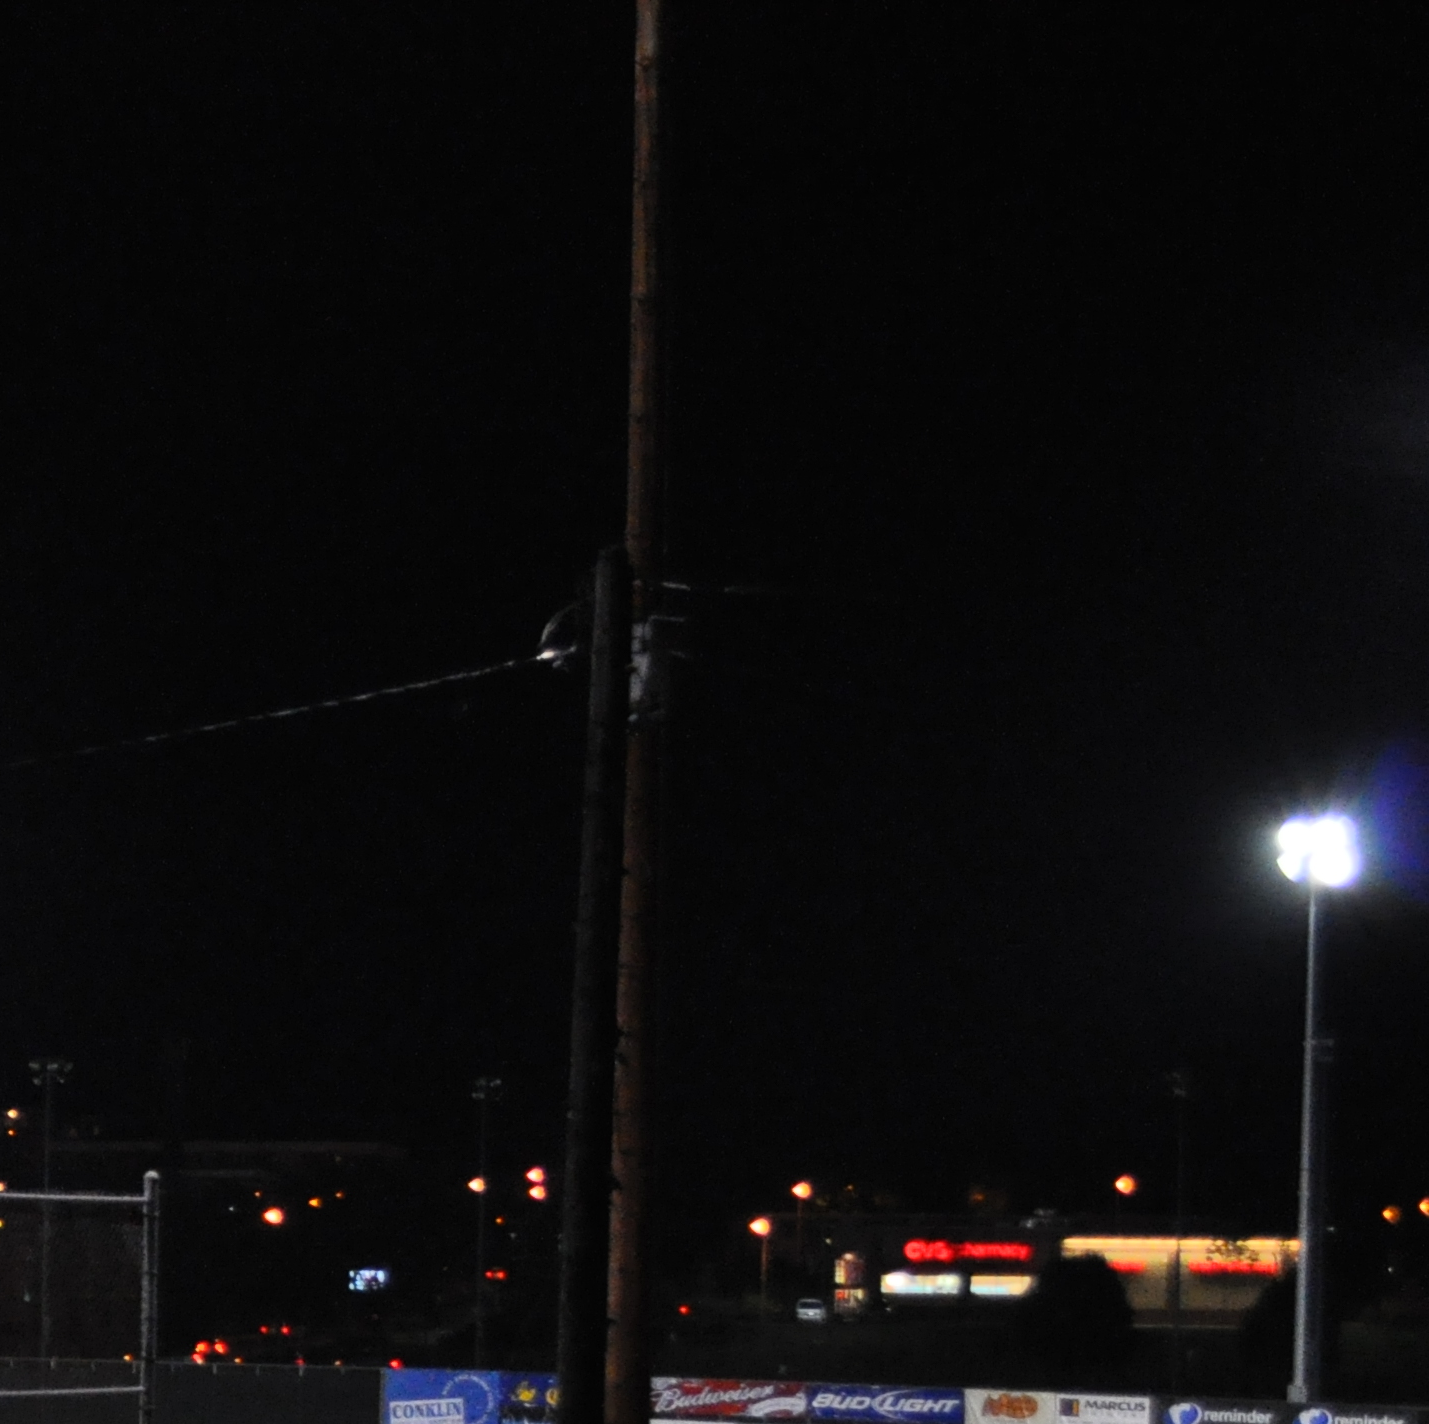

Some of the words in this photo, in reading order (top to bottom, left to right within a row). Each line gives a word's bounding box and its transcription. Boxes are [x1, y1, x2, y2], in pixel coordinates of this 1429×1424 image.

[650, 1385, 774, 1413] Budweiser
[812, 1393, 871, 1410] BUD
[883, 1398, 959, 1413] LIGHT
[1084, 1400, 1146, 1412] MARCUS
[392, 1401, 462, 1419] CONKLIN
[1203, 1409, 1272, 1424] reminder
